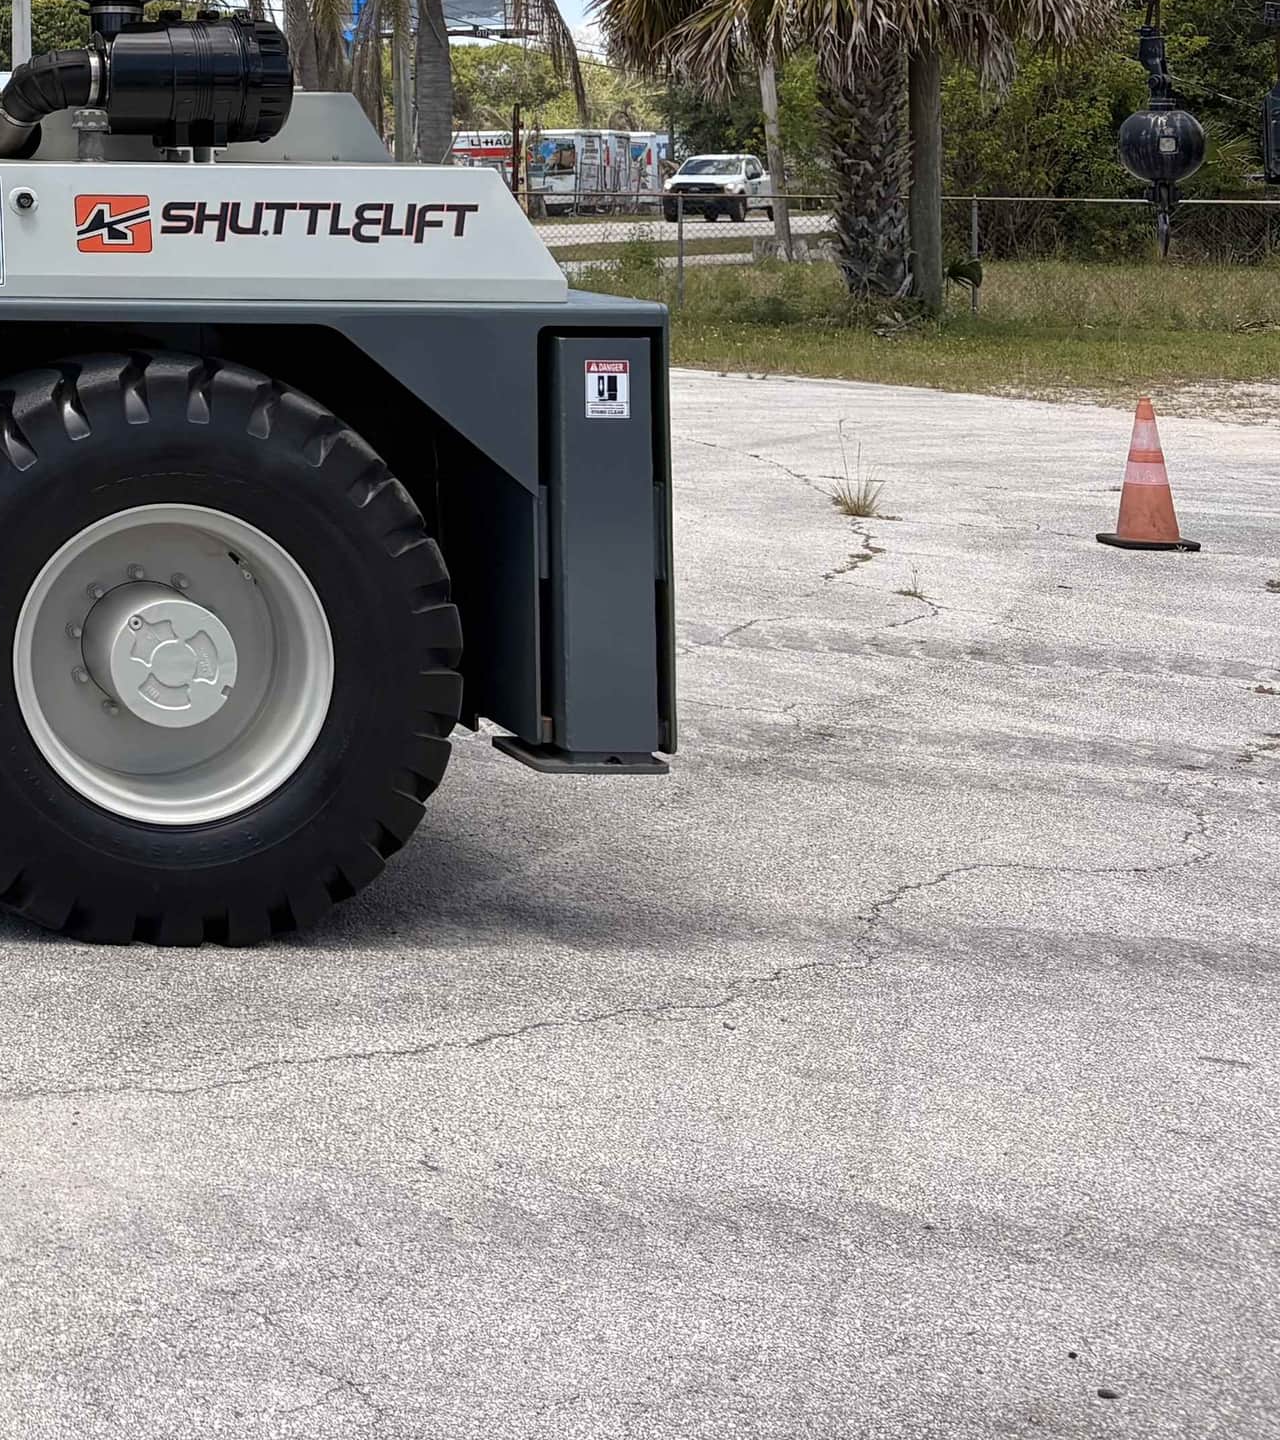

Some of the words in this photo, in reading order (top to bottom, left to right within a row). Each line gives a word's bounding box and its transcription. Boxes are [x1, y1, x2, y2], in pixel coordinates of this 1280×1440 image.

[470, 138, 514, 147] U-HAU
[160, 201, 479, 244] SHUTTLELIFT
[599, 363, 624, 372] DANGER
